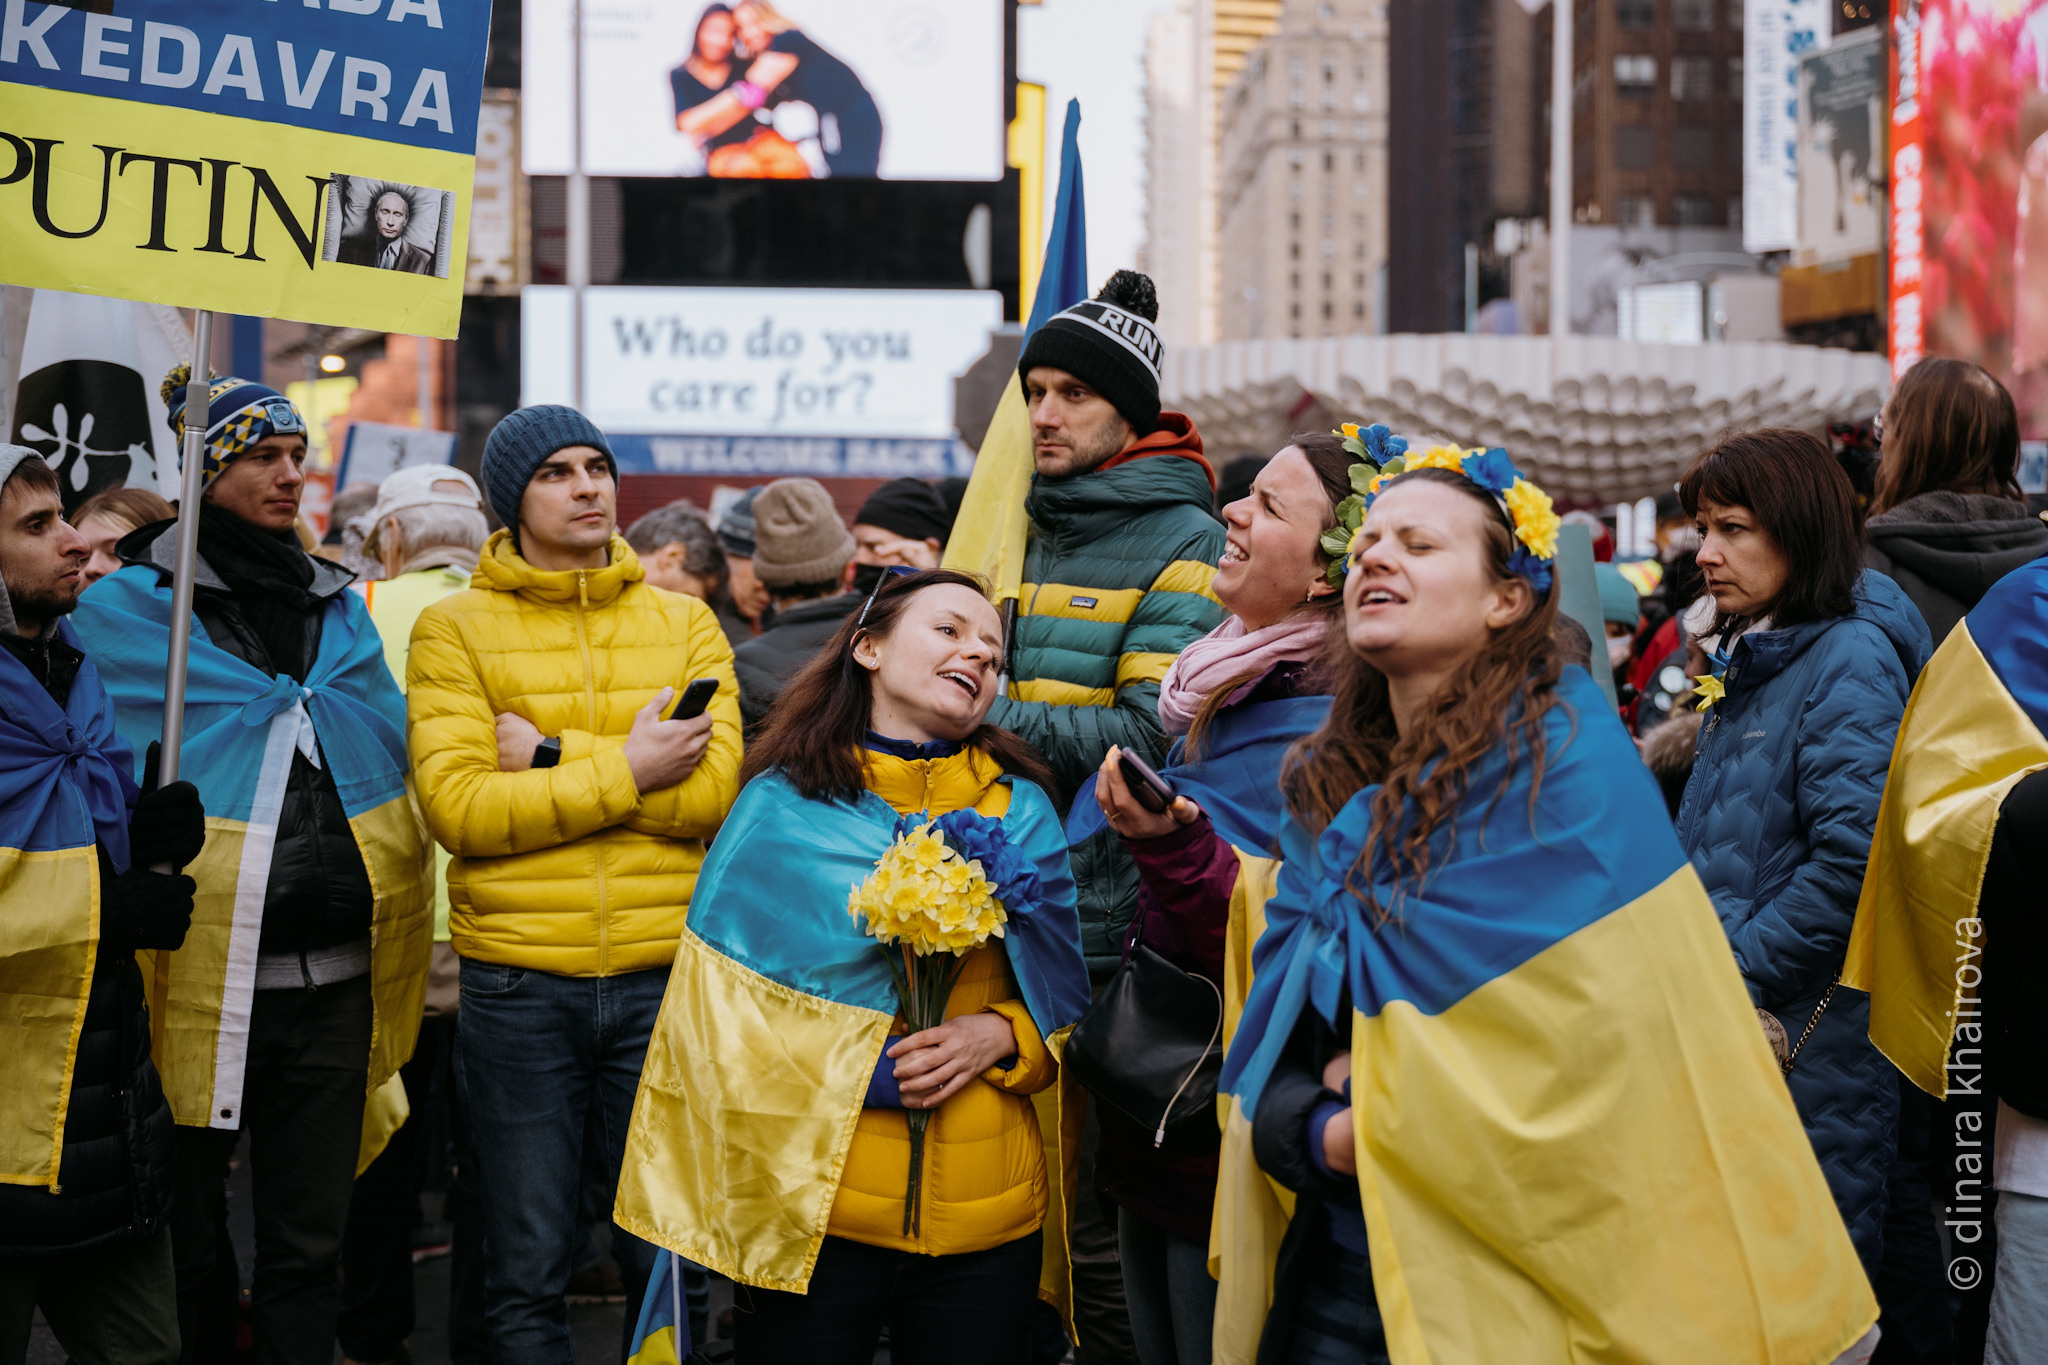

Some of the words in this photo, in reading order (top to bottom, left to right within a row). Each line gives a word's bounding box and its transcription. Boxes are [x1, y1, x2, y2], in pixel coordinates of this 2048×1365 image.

[0, 0, 454, 134] KEDAVRA
[1894, 143, 1922, 288] COME
[611, 315, 729, 358] Who
[745, 315, 804, 359] do
[821, 329, 912, 374] you
[650, 380, 756, 413] care
[769, 368, 873, 429] for?
[650, 437, 841, 475] WELCOME
[845, 439, 947, 477] BACK
